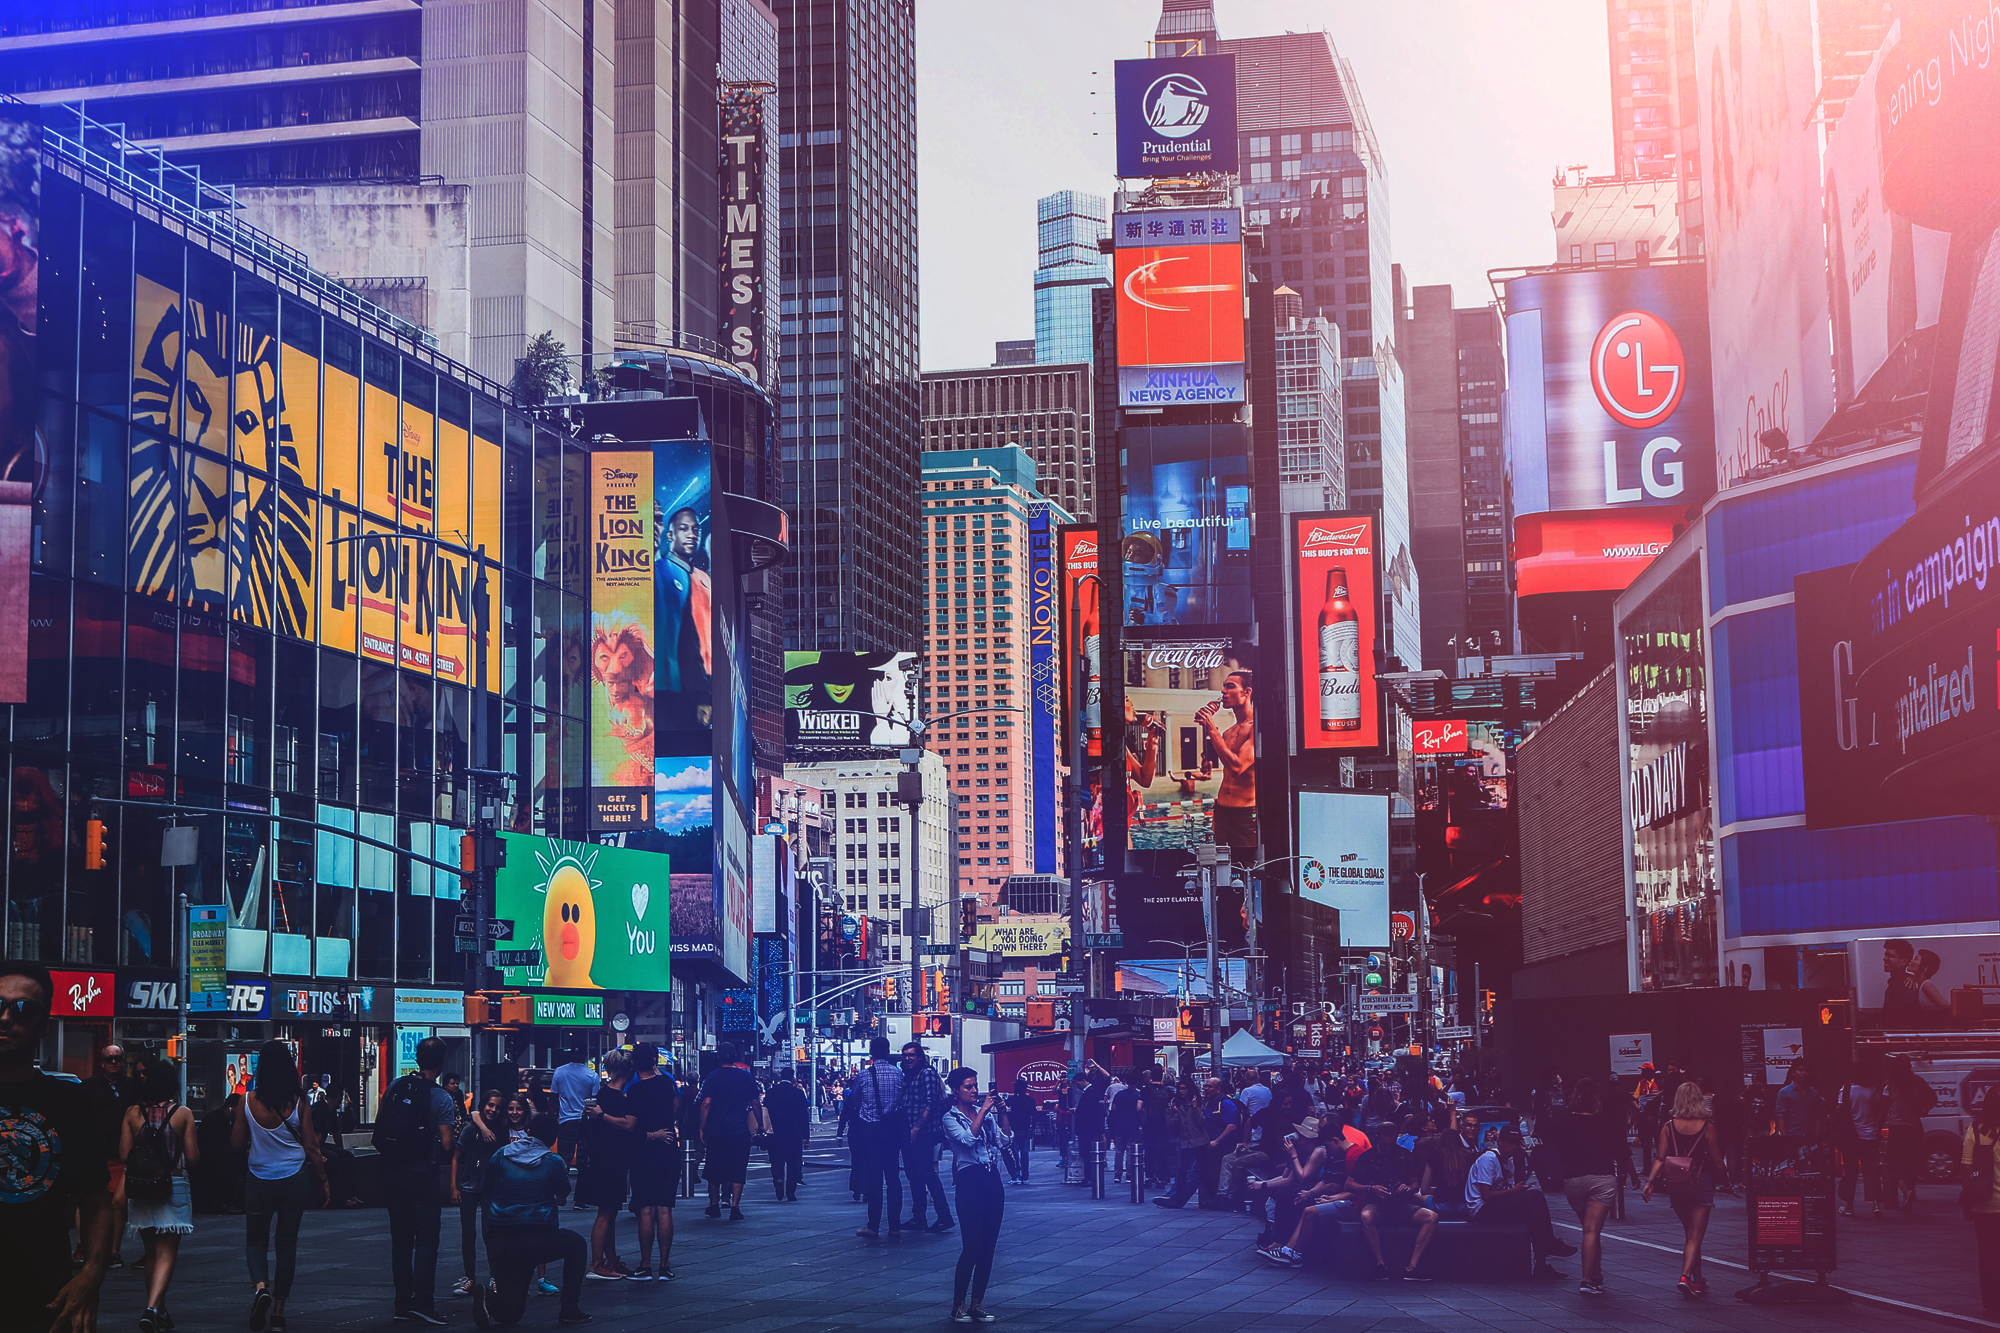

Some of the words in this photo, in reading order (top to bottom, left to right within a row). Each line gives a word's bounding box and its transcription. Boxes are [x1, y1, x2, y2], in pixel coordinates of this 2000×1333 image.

[1142, 139, 1211, 154] Prudential
[1177, 153, 1211, 161] Challenges
[1851, 186, 1869, 229] cher
[726, 135, 757, 304] TIMES
[1126, 218, 1228, 238] 新华通讯社
[1851, 249, 1876, 298] future
[1145, 370, 1219, 388] XINHUA
[1129, 389, 1172, 402] NEWS
[1175, 387, 1236, 401] AGENCY
[384, 442, 432, 509] THE
[601, 467, 638, 482] Disney
[1603, 436, 1685, 504] LG
[604, 495, 636, 510] THE
[599, 514, 643, 540] LION
[1132, 518, 1161, 530] Live
[1166, 515, 1234, 528] beautiful
[1308, 532, 1361, 542] Budweiser
[331, 488, 409, 612] LION
[1301, 550, 1317, 558] THIS
[1318, 549, 1339, 557] BUD'S
[1340, 548, 1354, 556] FOR
[1355, 547, 1371, 555] YOU.
[596, 542, 650, 574] KING
[1067, 562, 1080, 570] THIS
[1032, 518, 1052, 646] NOVOTEL
[363, 635, 394, 656] ENTRANCE
[402, 648, 412, 661] ON
[414, 650, 430, 666] 45TH
[437, 657, 455, 673] STREET
[1416, 723, 1463, 749] Ray-Ban
[1630, 764, 1651, 832] OLD
[1653, 741, 1687, 820] NAVY
[598, 804, 636, 812] TICKETS
[1328, 866, 1340, 878] THE
[1340, 867, 1364, 879] GLOBAL
[1365, 867, 1385, 879] GOALS
[192, 931, 225, 939] BROADWAY
[488, 924, 505, 934] WAY
[995, 928, 1017, 936] WHAT
[626, 921, 656, 956] YOU
[1018, 935, 1044, 943] DOING
[1087, 936, 1095, 946] W
[1098, 936, 1111, 946] 44
[930, 946, 936, 954] W
[938, 946, 947, 954] 44
[992, 944, 1017, 952] DOWN
[1019, 943, 1048, 951] THERE?
[501, 953, 510, 964] W
[514, 953, 527, 964] 44
[69, 976, 101, 1012] Ray-Ban
[309, 991, 360, 1015] TISST
[537, 1002, 556, 1018] NEW
[556, 1003, 576, 1019] YORK
[584, 1004, 600, 1019] LINE
[1154, 1022, 1173, 1030] HOP
[1311, 1023, 1323, 1047] tkts
